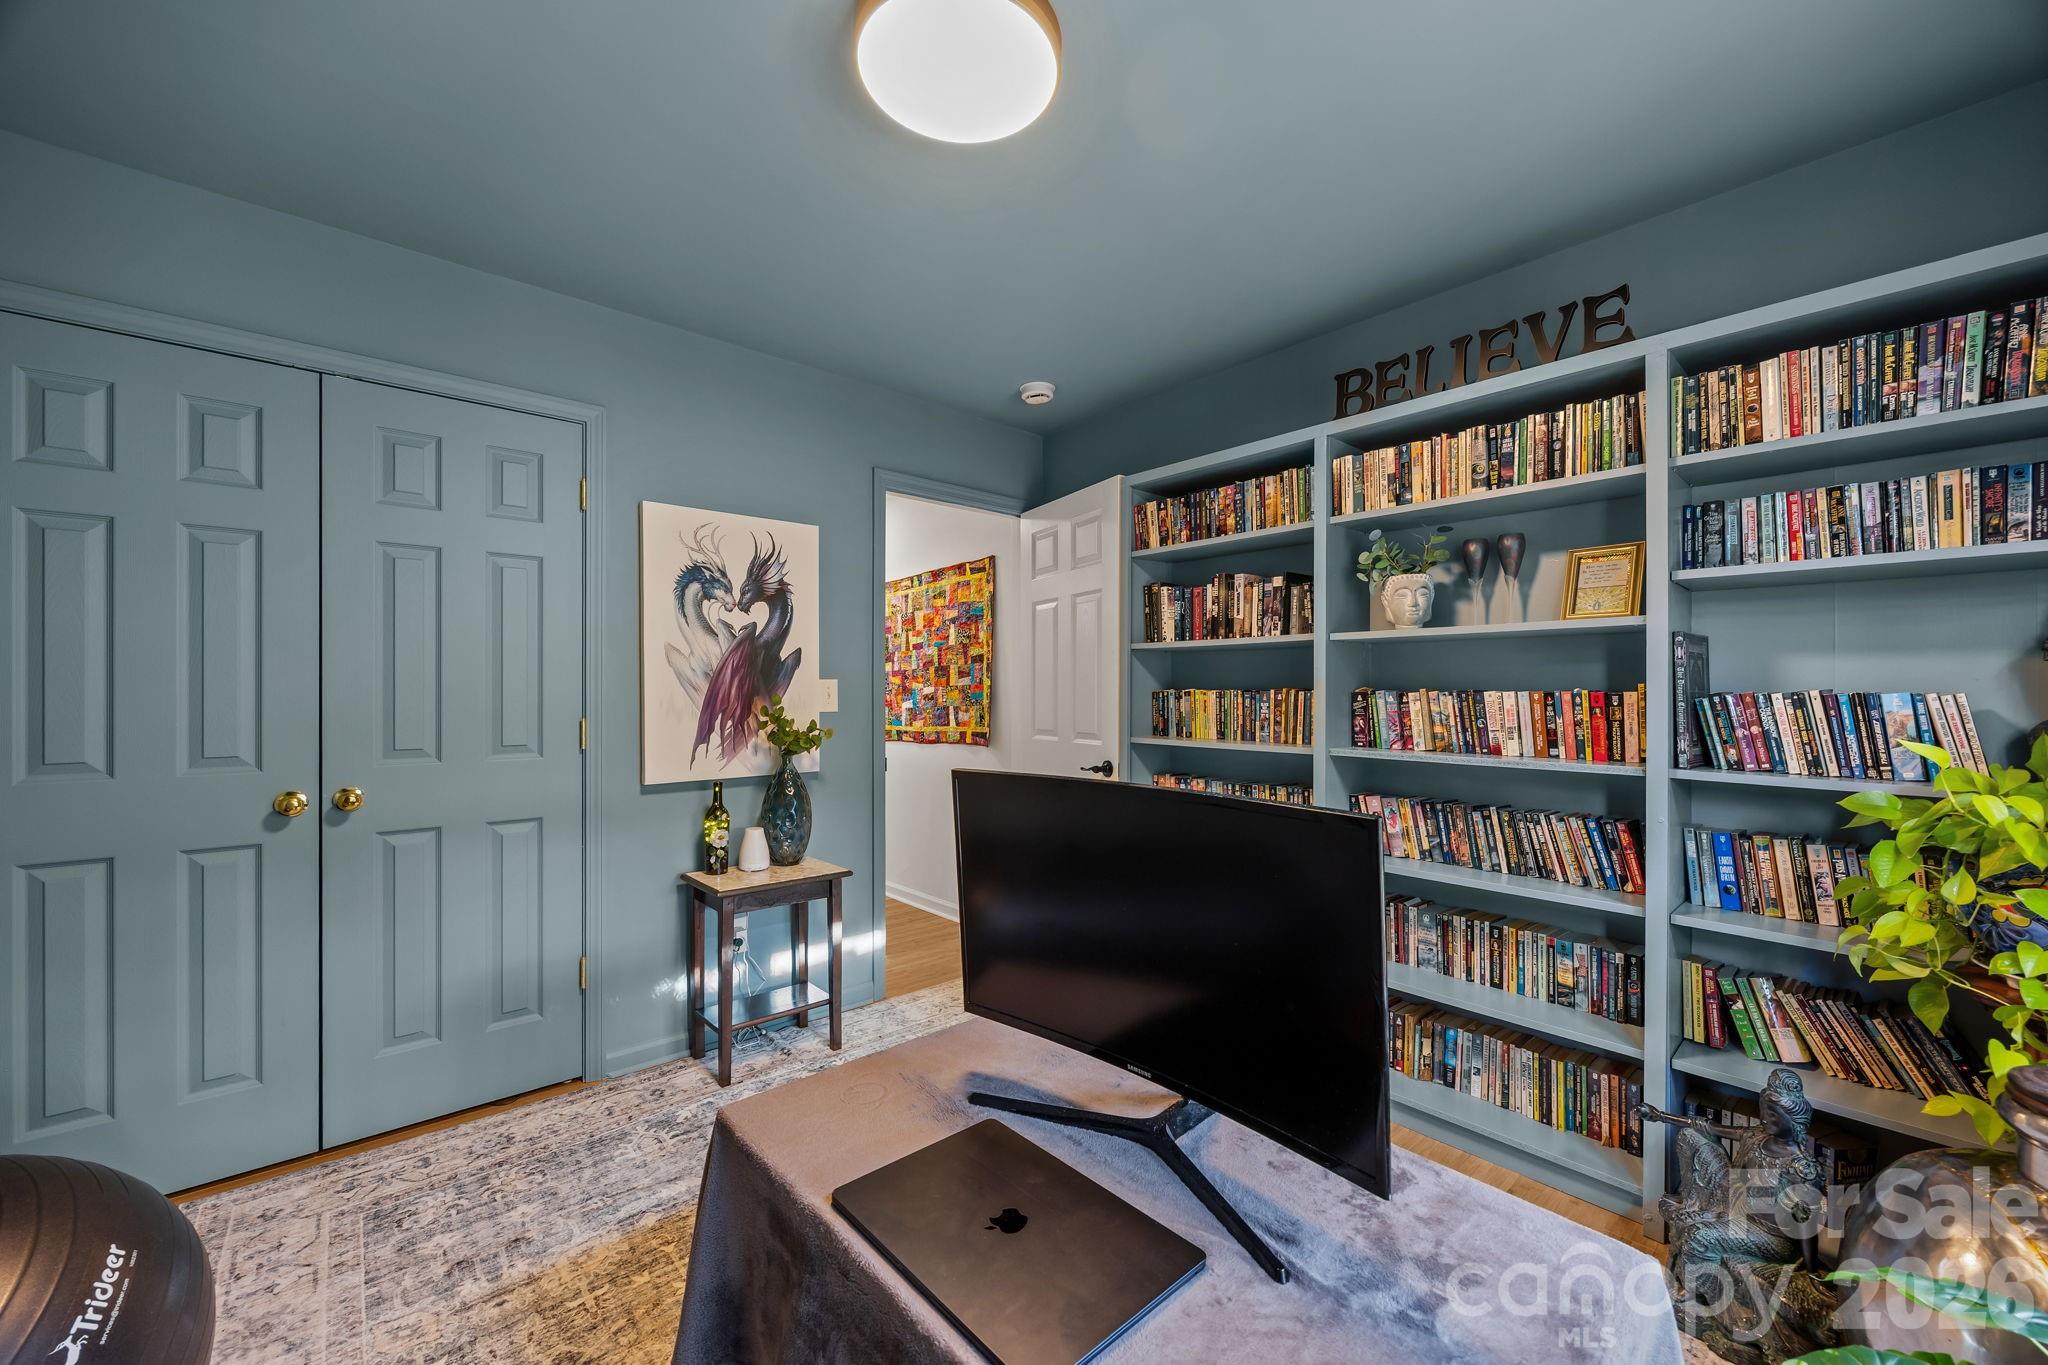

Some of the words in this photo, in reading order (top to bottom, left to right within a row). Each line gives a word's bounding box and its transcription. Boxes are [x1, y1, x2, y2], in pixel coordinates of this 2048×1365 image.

[1332, 283, 1636, 421] BELIEVE
[1986, 489, 1994, 508] SHORE
[1677, 666, 1686, 678] The
[1676, 679, 1686, 701] Dragon
[1677, 702, 1686, 733] Chronicles
[1721, 873, 1735, 882] BRIN
[1127, 1063, 1152, 1079] SAMSUNG
[69, 1243, 126, 1334] Trideer
